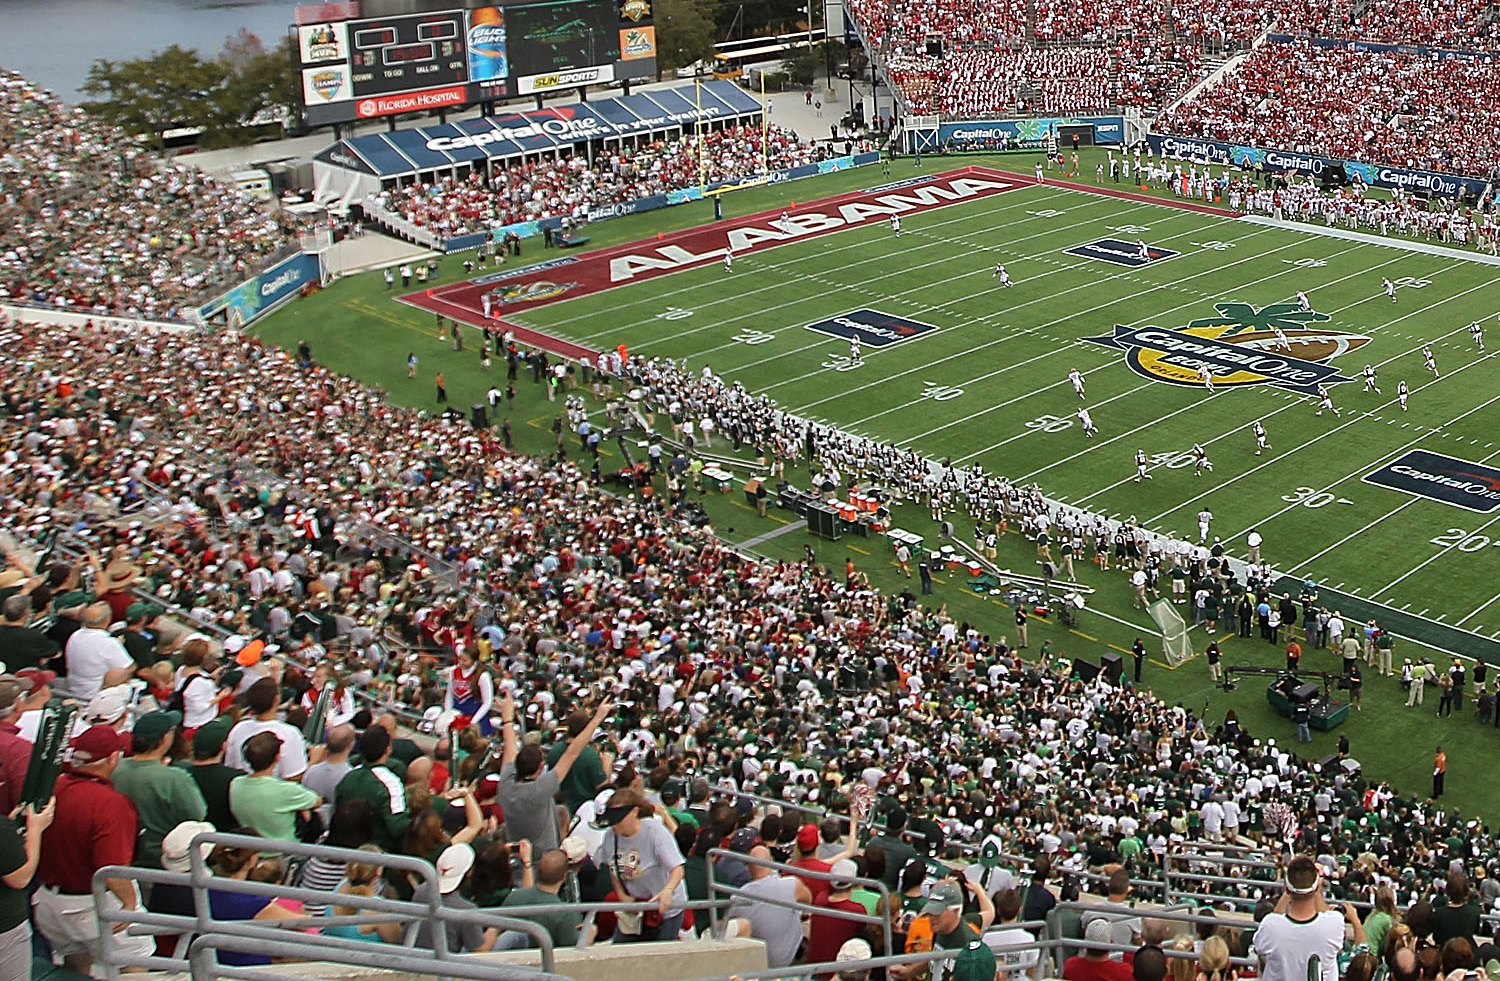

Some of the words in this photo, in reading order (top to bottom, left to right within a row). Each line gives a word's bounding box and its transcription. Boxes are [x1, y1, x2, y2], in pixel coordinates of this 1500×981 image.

[534, 77, 558, 87] SUN
[558, 69, 599, 84] SPORTS
[378, 98, 416, 112] FLORIDA
[417, 91, 460, 107] HOSPITAL
[953, 128, 1012, 141] CapitalOne
[1379, 169, 1456, 194] CapitalOne
[587, 203, 637, 222] pitalOne
[609, 178, 1013, 283] ALABAMA
[1134, 330, 1319, 382] CapitalOne
[1149, 364, 1206, 383] ORLAND
[1024, 414, 1074, 434] 50
[1150, 450, 1199, 470] 40
[1281, 486, 1335, 509] 30
[1430, 528, 1491, 553] 20
